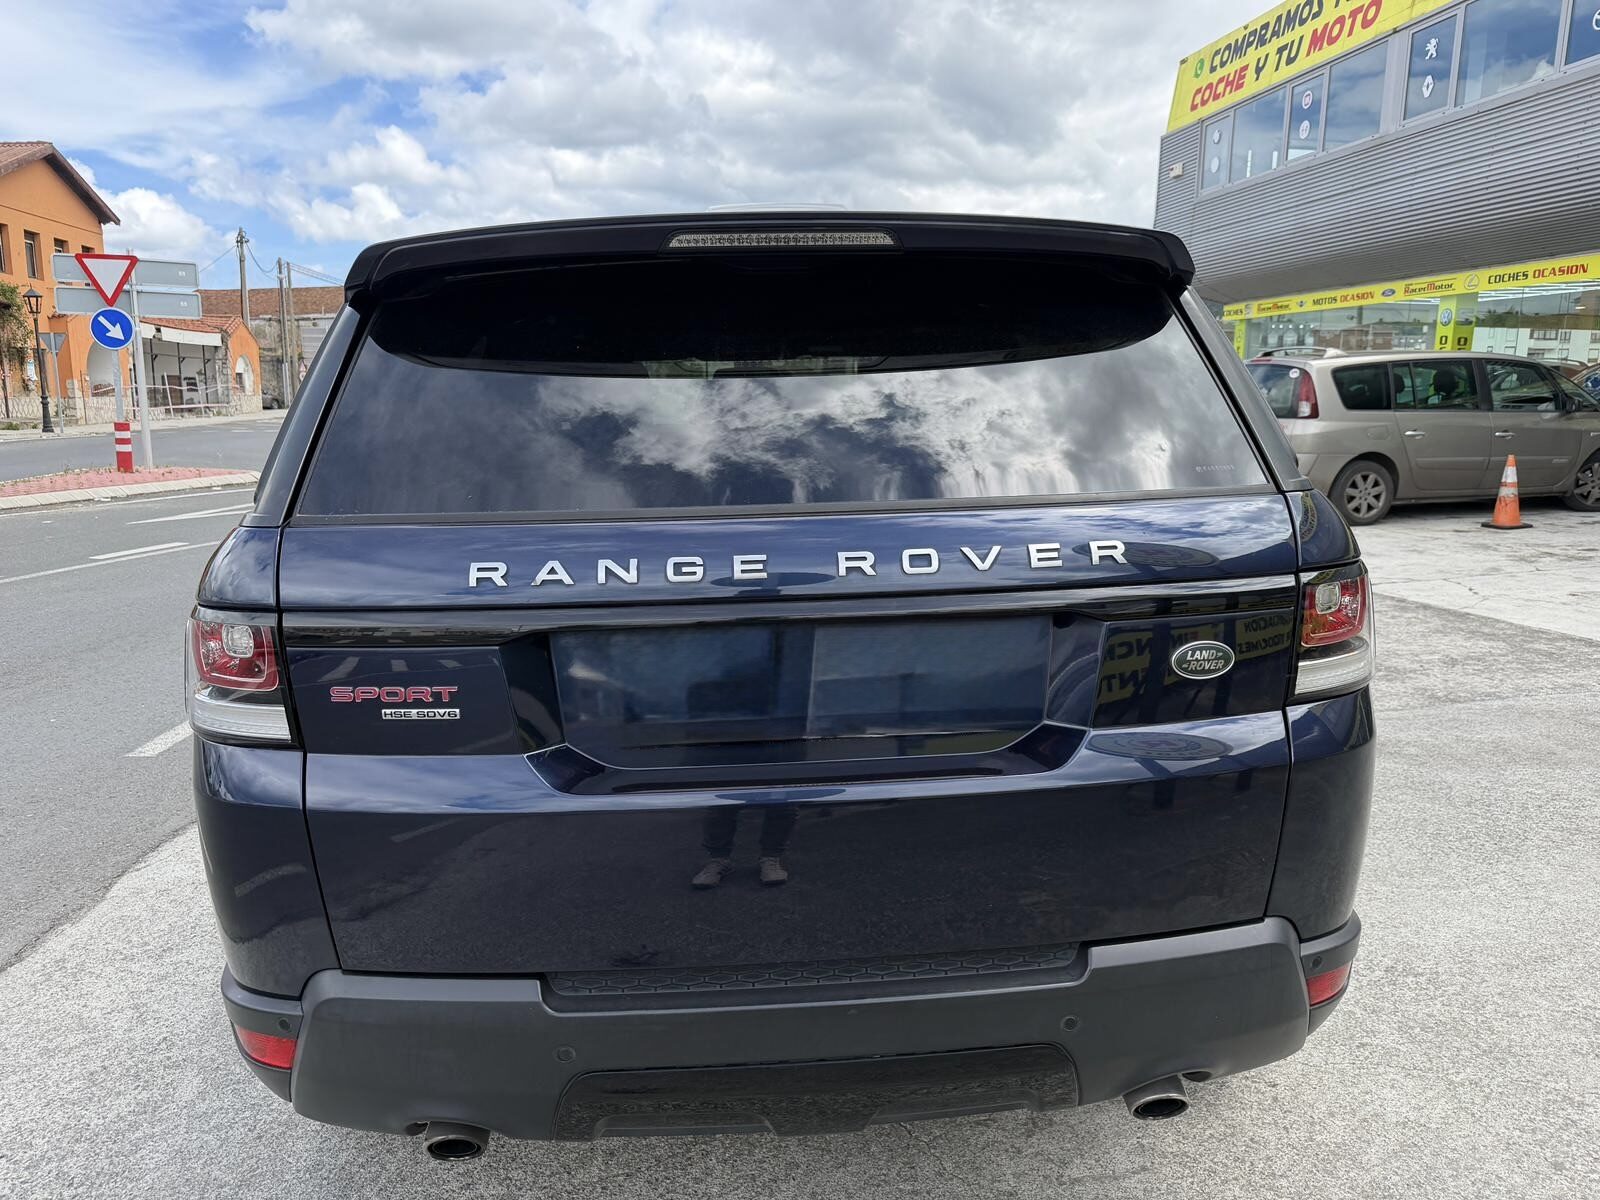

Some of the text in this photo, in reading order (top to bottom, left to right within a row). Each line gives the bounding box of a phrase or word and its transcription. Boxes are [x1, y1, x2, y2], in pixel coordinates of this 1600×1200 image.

[1190, 0, 1382, 112] COCHE Y TU MOTO
[1488, 263, 1588, 285] COCHES OCASION
[1312, 295, 1337, 306] MOTOS
[1339, 290, 1375, 303] OCASION
[468, 540, 1128, 587] RANGE ROVER
[1186, 650, 1217, 660] LAND
[1188, 660, 1224, 670] ROVER
[329, 686, 458, 703] SPORT
[383, 710, 458, 719] HSE SDV6
